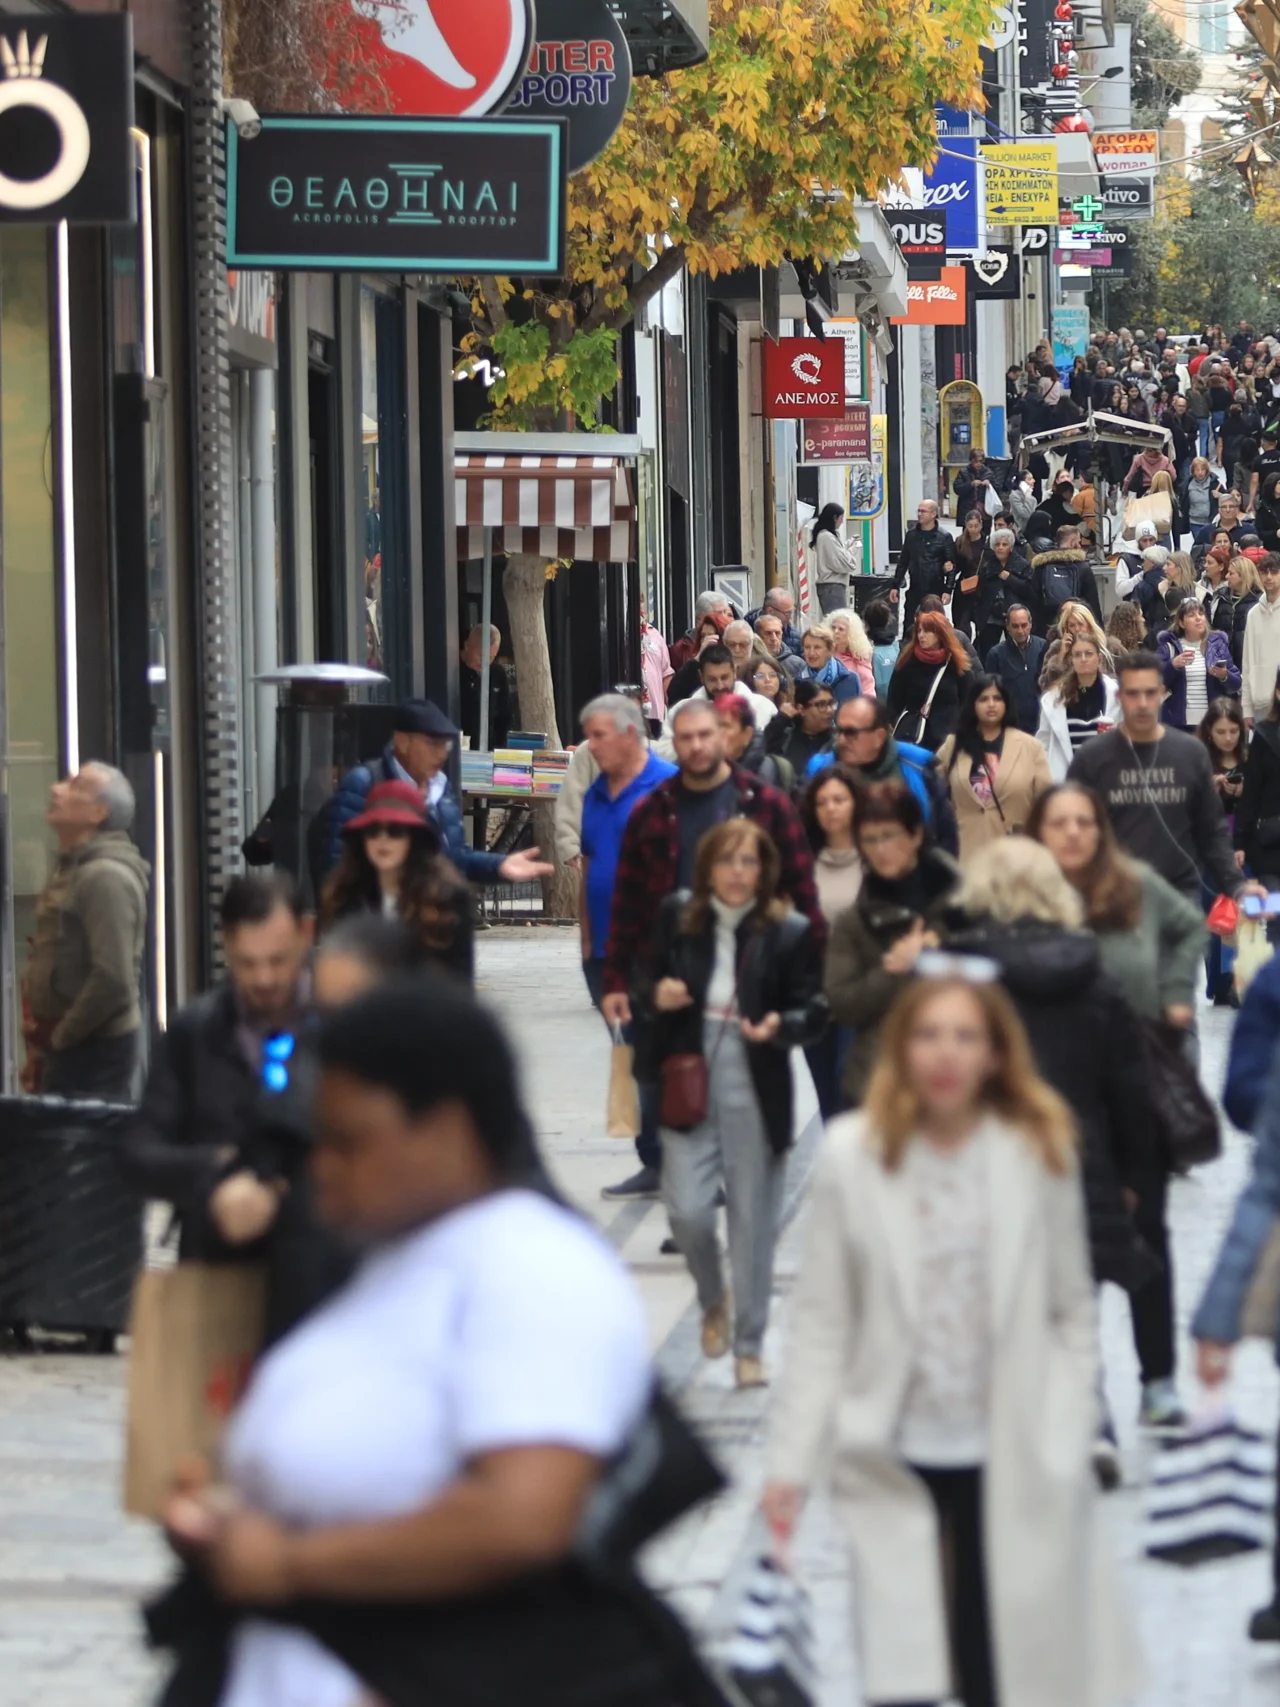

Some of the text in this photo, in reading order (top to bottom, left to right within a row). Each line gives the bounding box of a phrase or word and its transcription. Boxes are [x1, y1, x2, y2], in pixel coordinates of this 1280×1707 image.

[1096, 133, 1149, 145] ΑΓΟΡΑ
[292, 212, 518, 227] ACROPOLIS ROOFTOP
[774, 391, 840, 405] ΑΝΕΜΟΣ
[805, 438, 867, 451] e-paramana
[1120, 767, 1175, 785] OBSERVE
[1109, 787, 1188, 804] MOVEMENT
